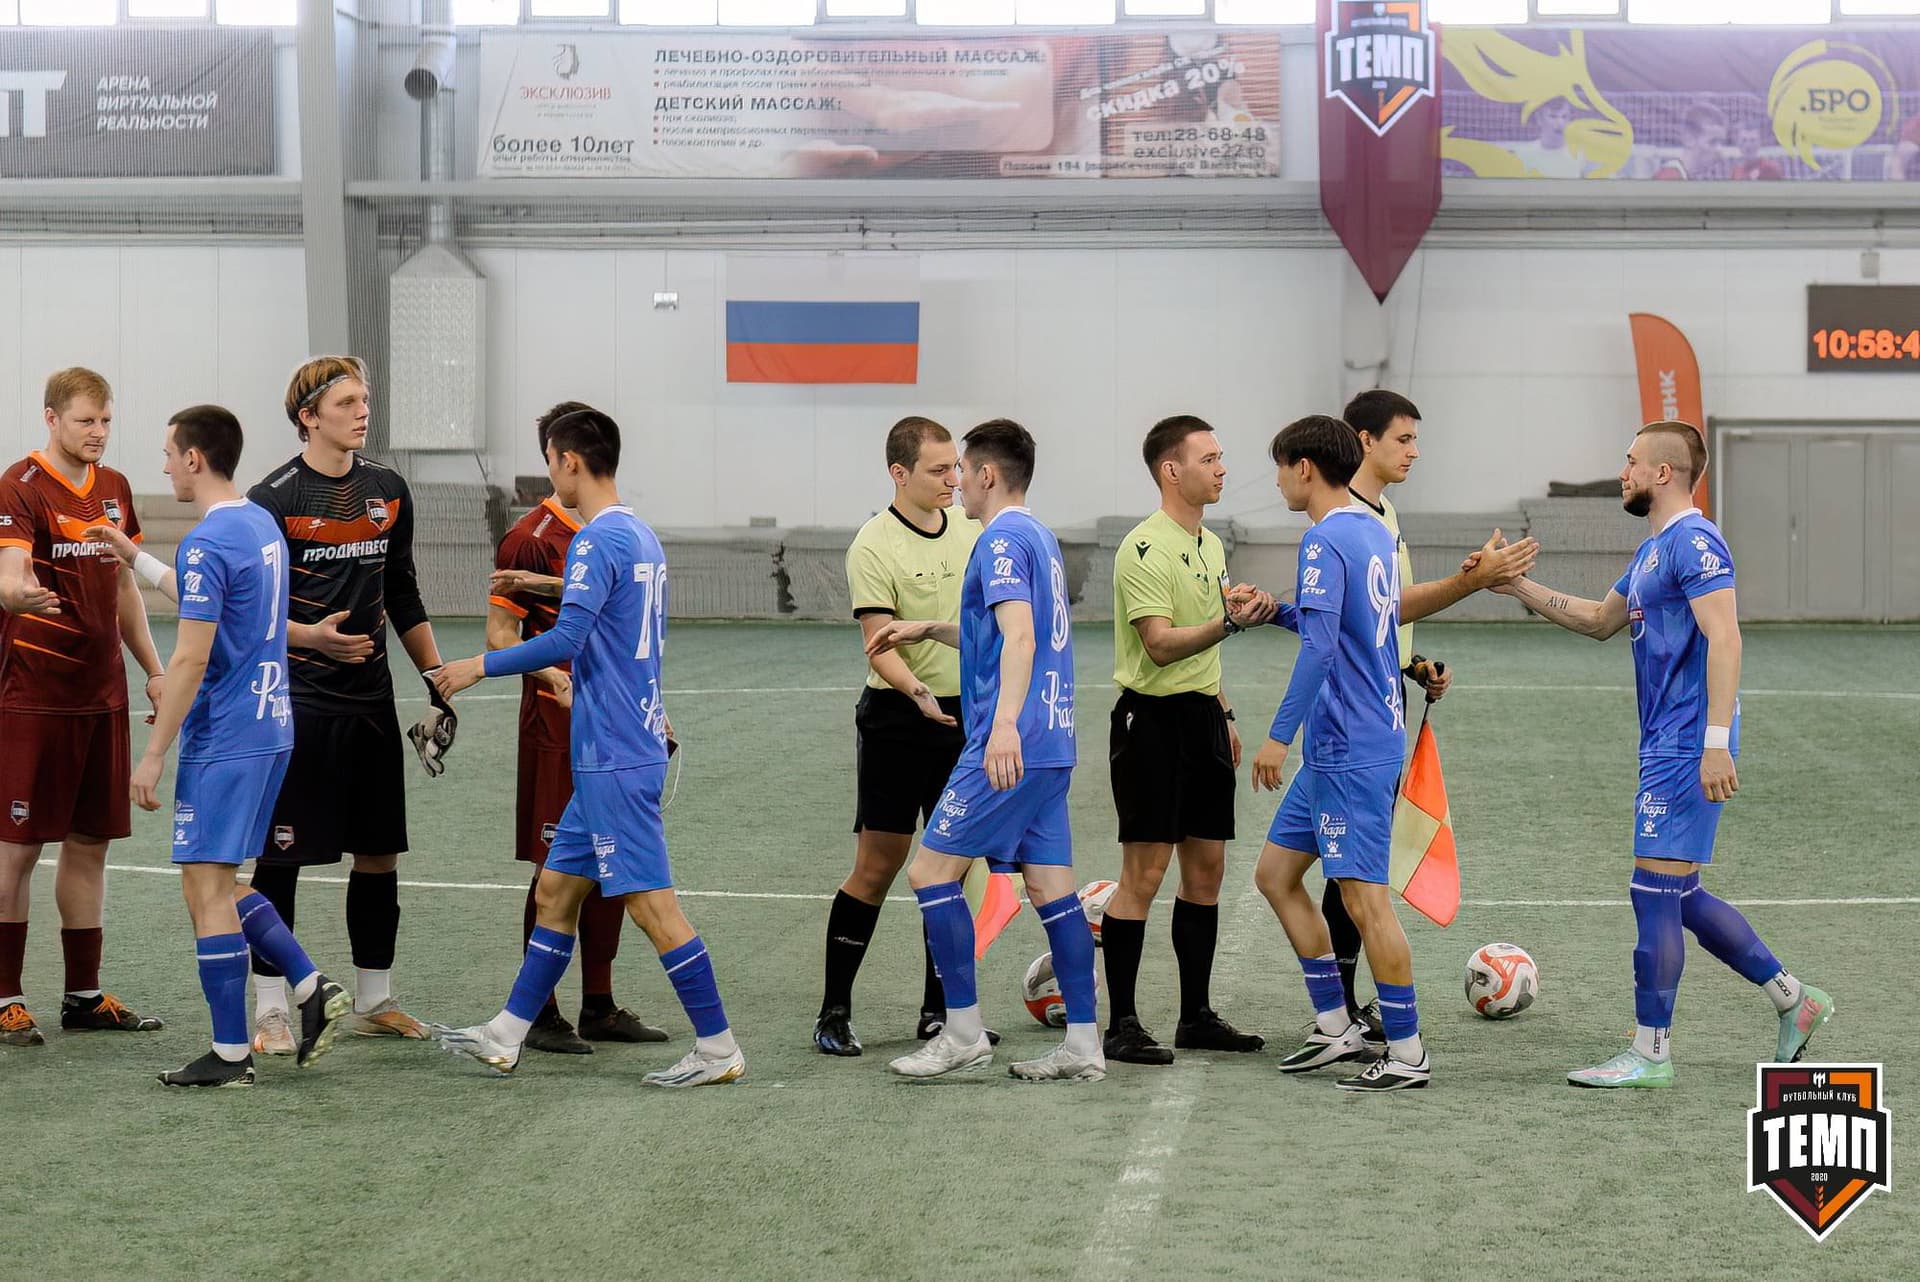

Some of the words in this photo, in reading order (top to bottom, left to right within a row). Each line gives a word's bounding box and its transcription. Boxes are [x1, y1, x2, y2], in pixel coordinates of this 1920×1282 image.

[655, 48, 948, 65] ЛЕЧЕБНО-ОЗДОРОВИТЕЛЬНЫЙ
[1336, 33, 1424, 82] ТЕМП
[1183, 54, 1247, 91] 20%
[97, 76, 150, 91] АРЕНА
[520, 86, 612, 100] ЭКСКЛЮЗИВ
[97, 91, 218, 111] ВИРТУАЛЬНОЙ
[655, 94, 744, 112] ДЕТСКИЙ
[97, 114, 209, 131] РЕАЛЬНОСТИ
[493, 134, 562, 153] более
[261, 541, 281, 641] 7
[1050, 556, 1069, 652] 8
[1640, 792, 1668, 818] Praga
[1320, 812, 1346, 838] Praga
